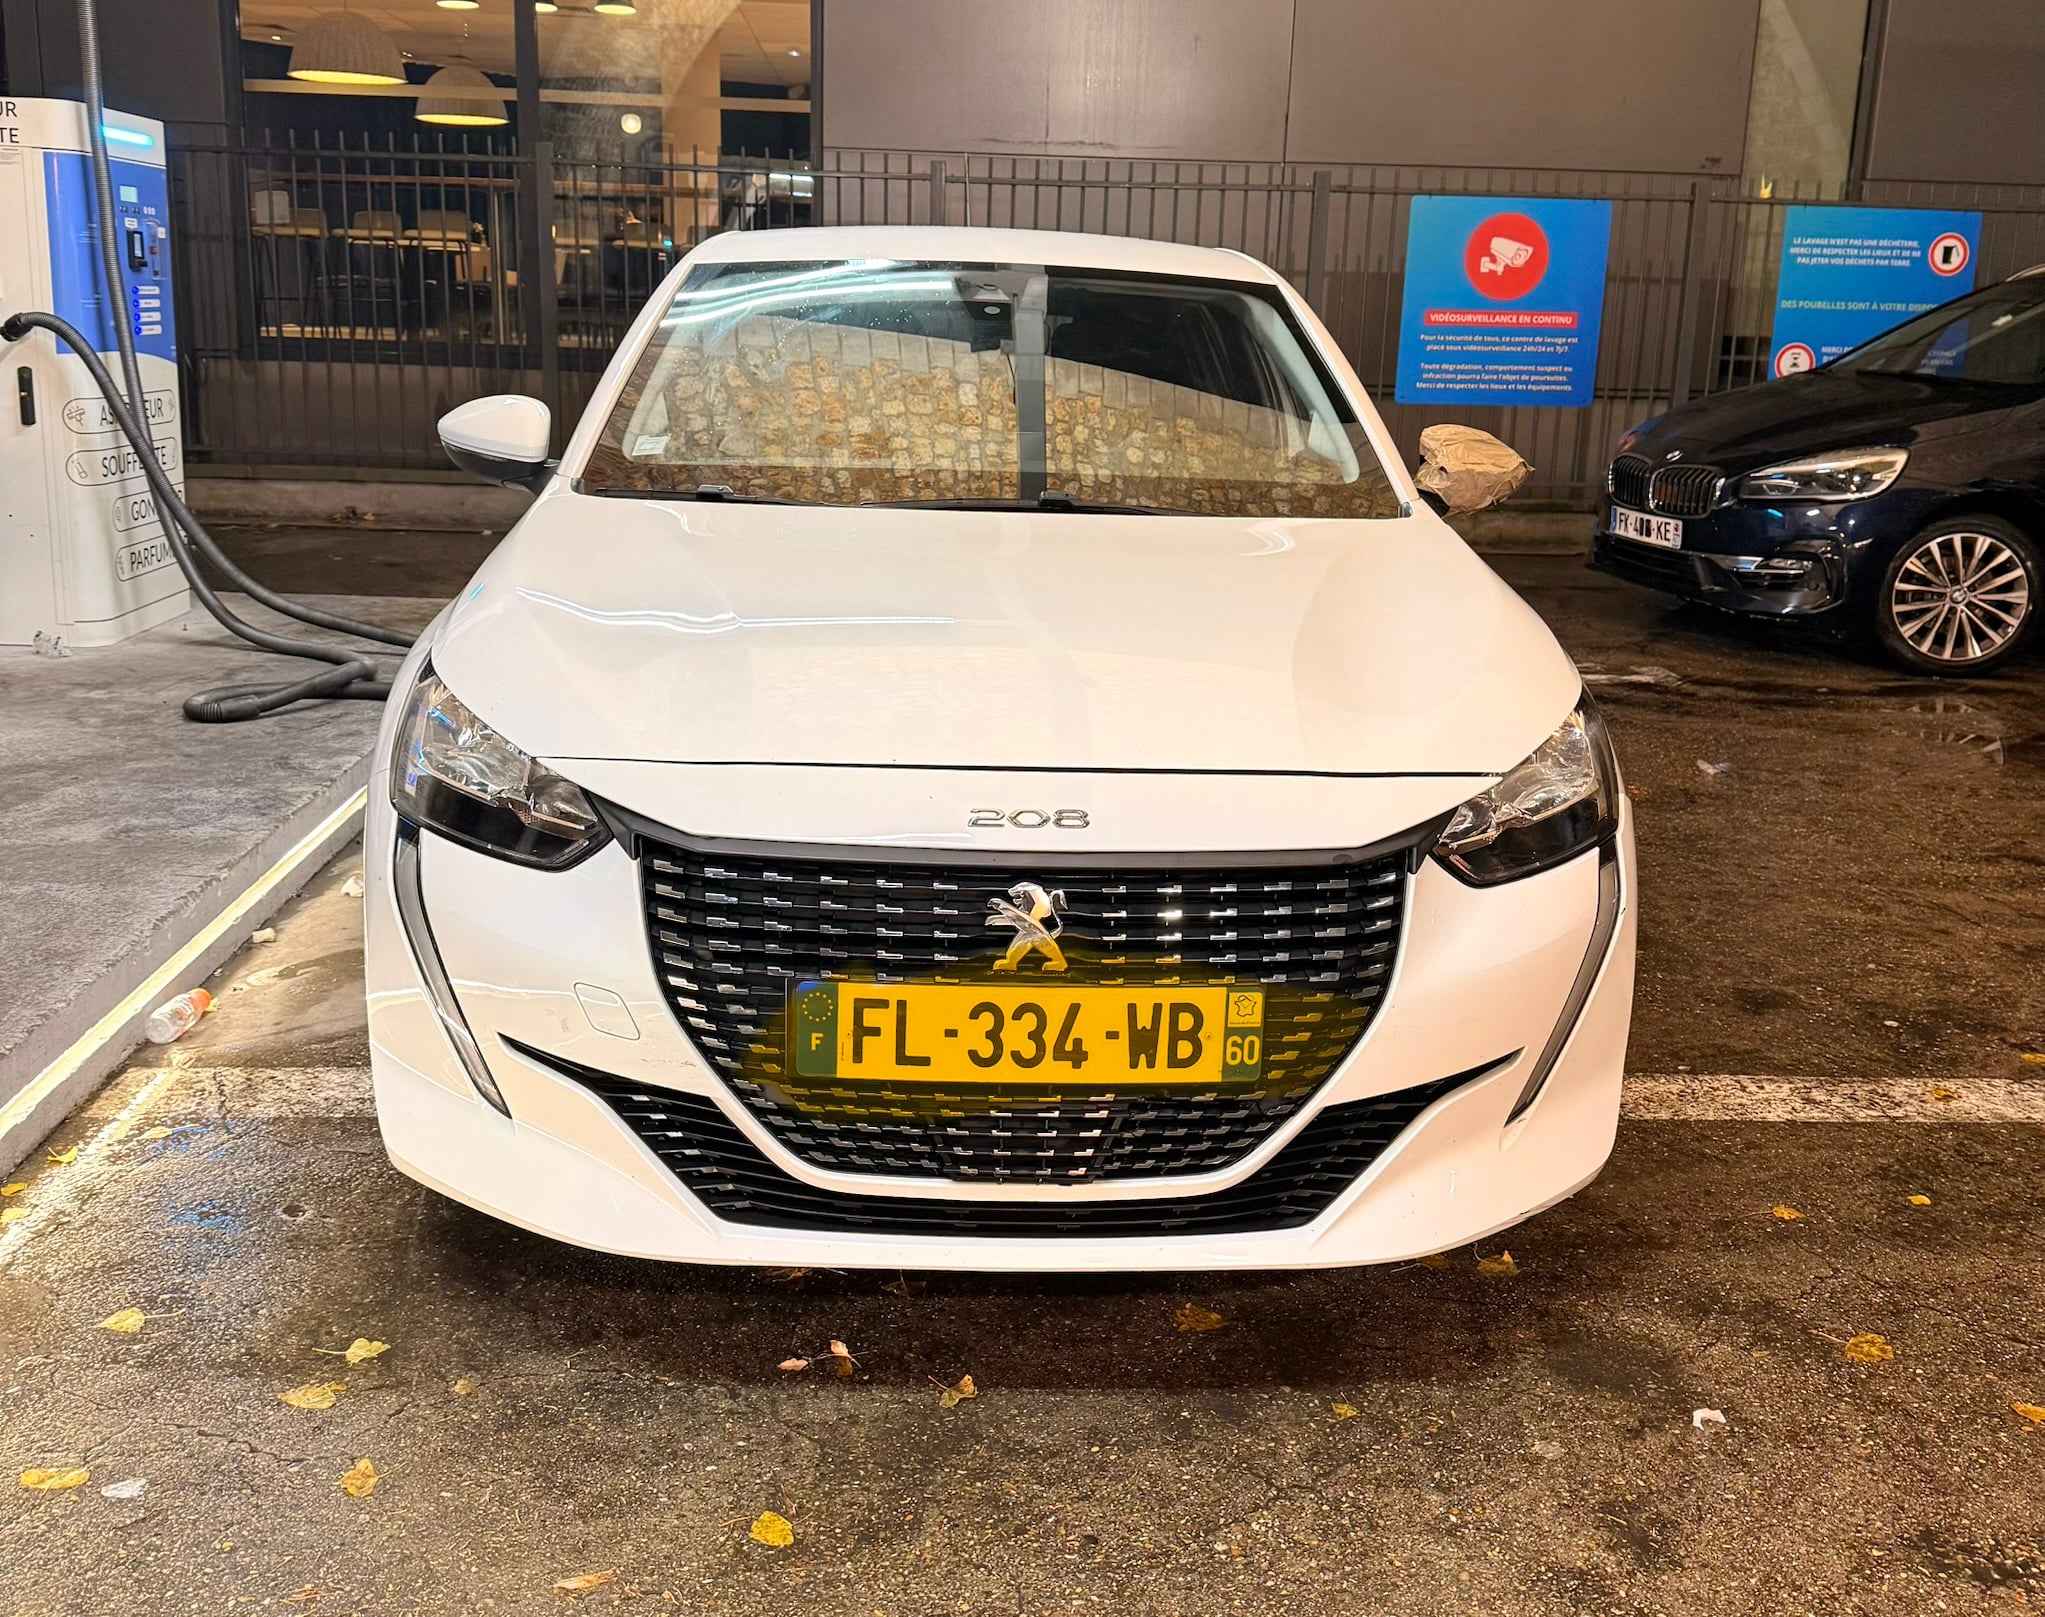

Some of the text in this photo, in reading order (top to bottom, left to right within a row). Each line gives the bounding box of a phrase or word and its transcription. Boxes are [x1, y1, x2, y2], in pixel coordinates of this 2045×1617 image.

[1802, 237, 1829, 245] LAVAGE
[1849, 238, 1862, 246] PAS
[1863, 239, 1878, 247] UNE
[1810, 257, 1829, 265] JETER
[1830, 257, 1844, 265] VOS
[1845, 257, 1875, 266] DÉCHETS
[1781, 300, 1797, 308] DES
[1799, 300, 1845, 309] POUBELLES
[1847, 302, 1870, 310] SONT
[1871, 300, 1878, 310] À
[1880, 302, 1906, 311] VOTRE
[1430, 312, 1573, 325] VIDÉOSURVEILLANCE EN CONTINU
[1544, 336, 1566, 345] lavage
[1426, 344, 1444, 352] placé
[1821, 345, 1843, 353] MERCI
[1441, 363, 1484, 371] dégradation,
[1485, 364, 1536, 372] comportement
[1498, 374, 1520, 382] l'objet
[102, 446, 167, 477] SOUFFTE
[967, 808, 1090, 829] 208
[852, 997, 1204, 1070] FL-334-WB
[811, 1032, 824, 1051] F
[1226, 1035, 1260, 1065] 60
